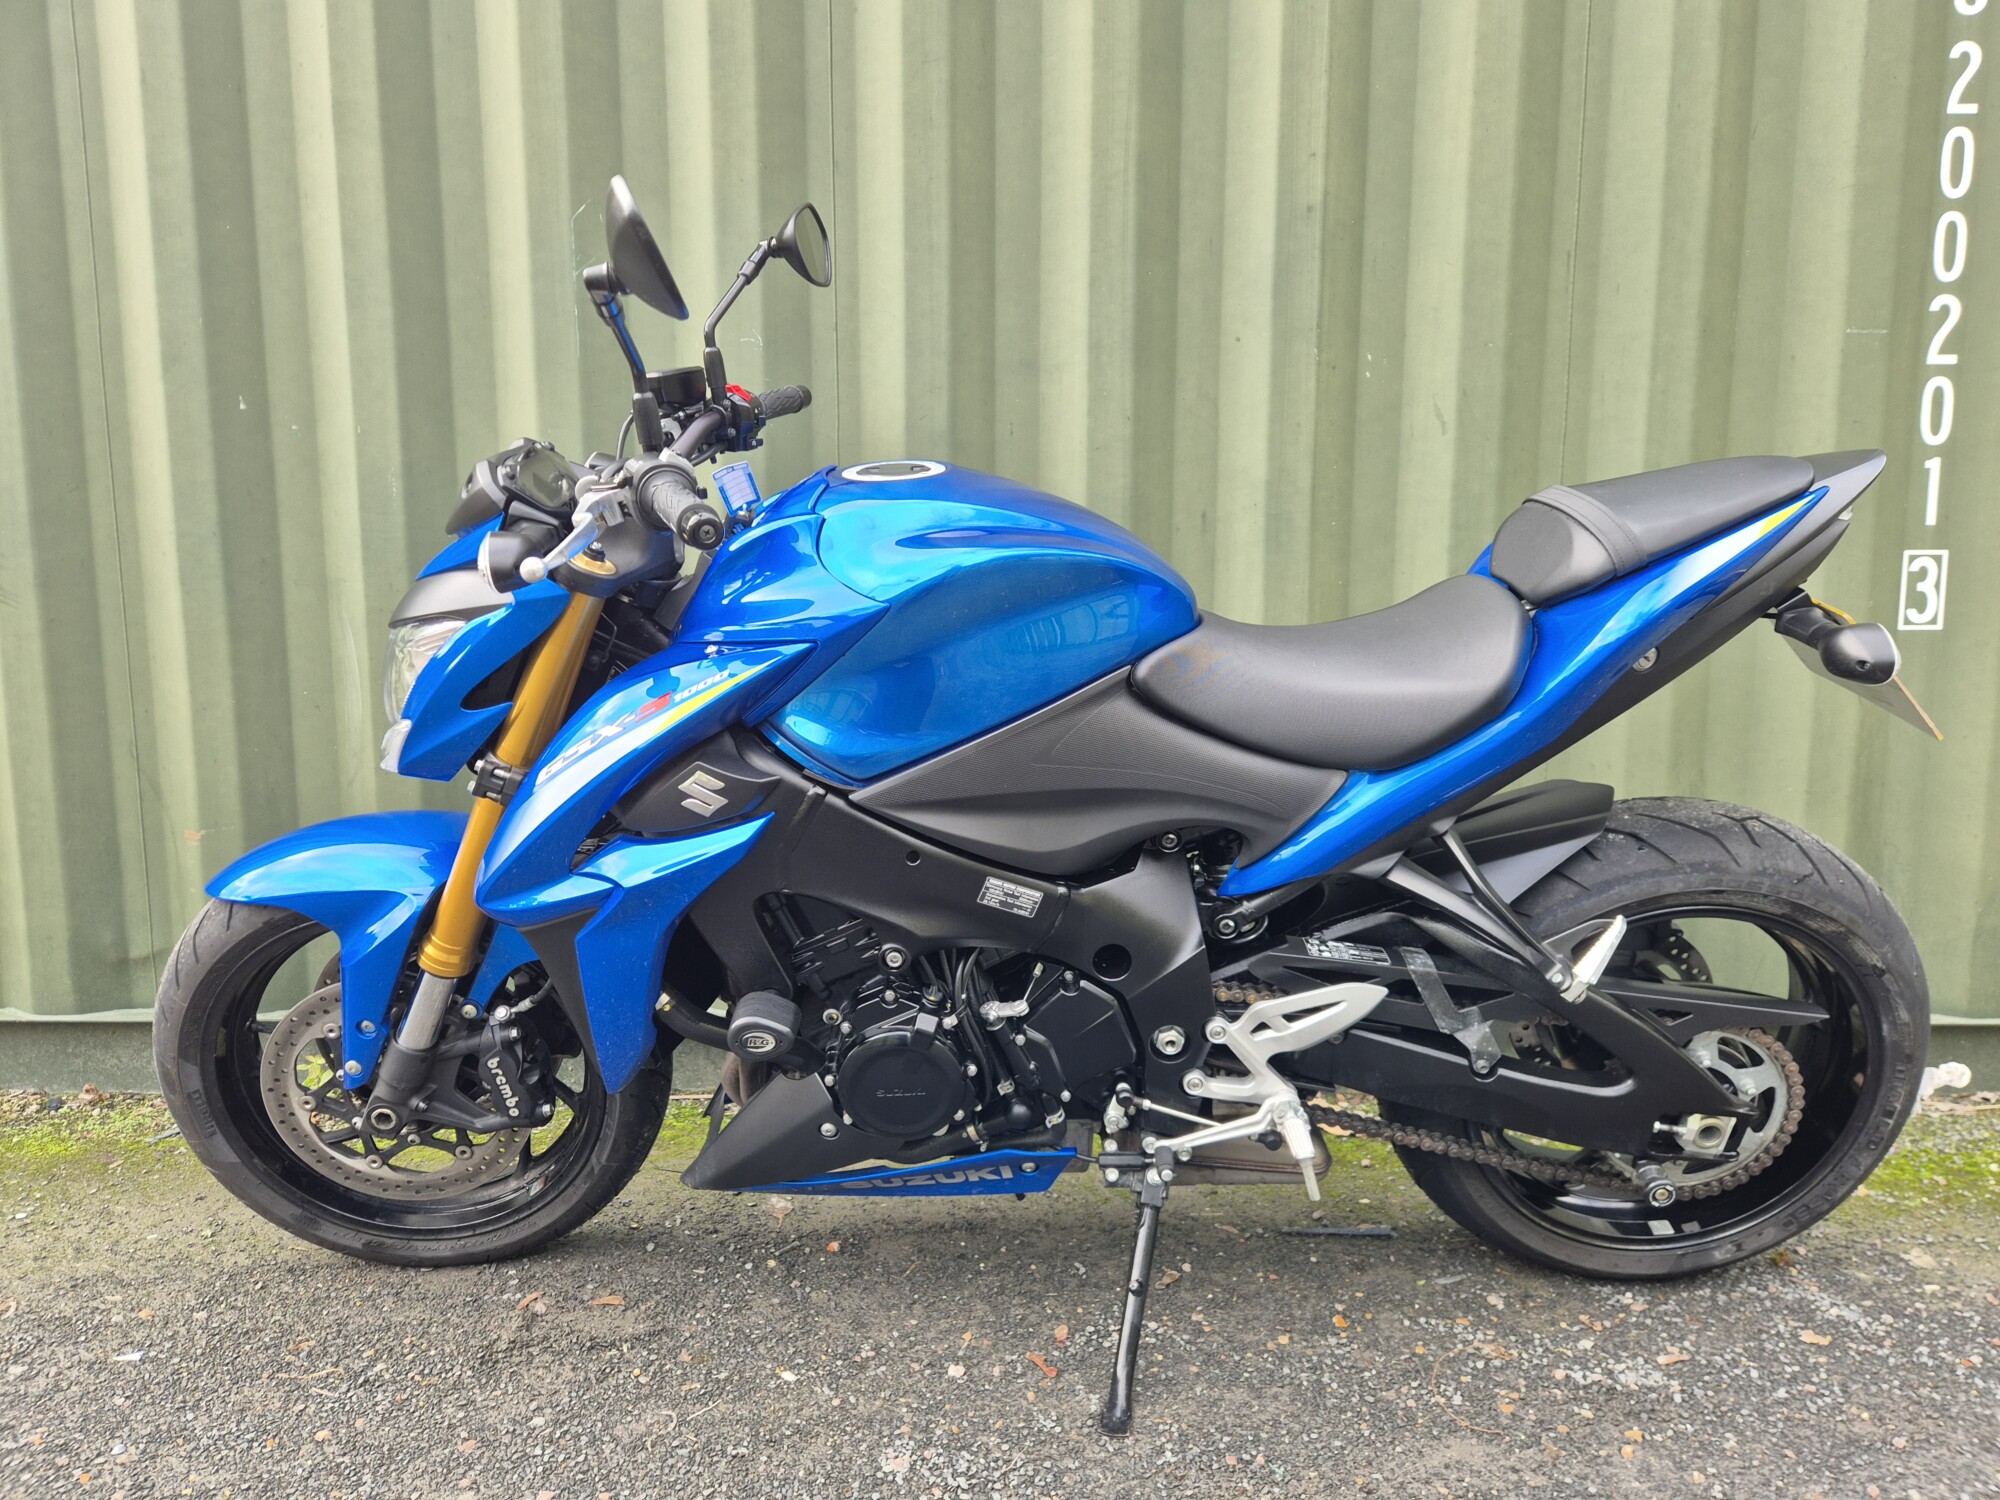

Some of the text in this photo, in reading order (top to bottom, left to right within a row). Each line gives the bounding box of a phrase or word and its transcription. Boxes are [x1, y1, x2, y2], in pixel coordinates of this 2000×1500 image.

[1906, 557, 1940, 624] 3
[487, 1056, 520, 1117] brembo
[840, 1165, 1014, 1189] SUZUKI
